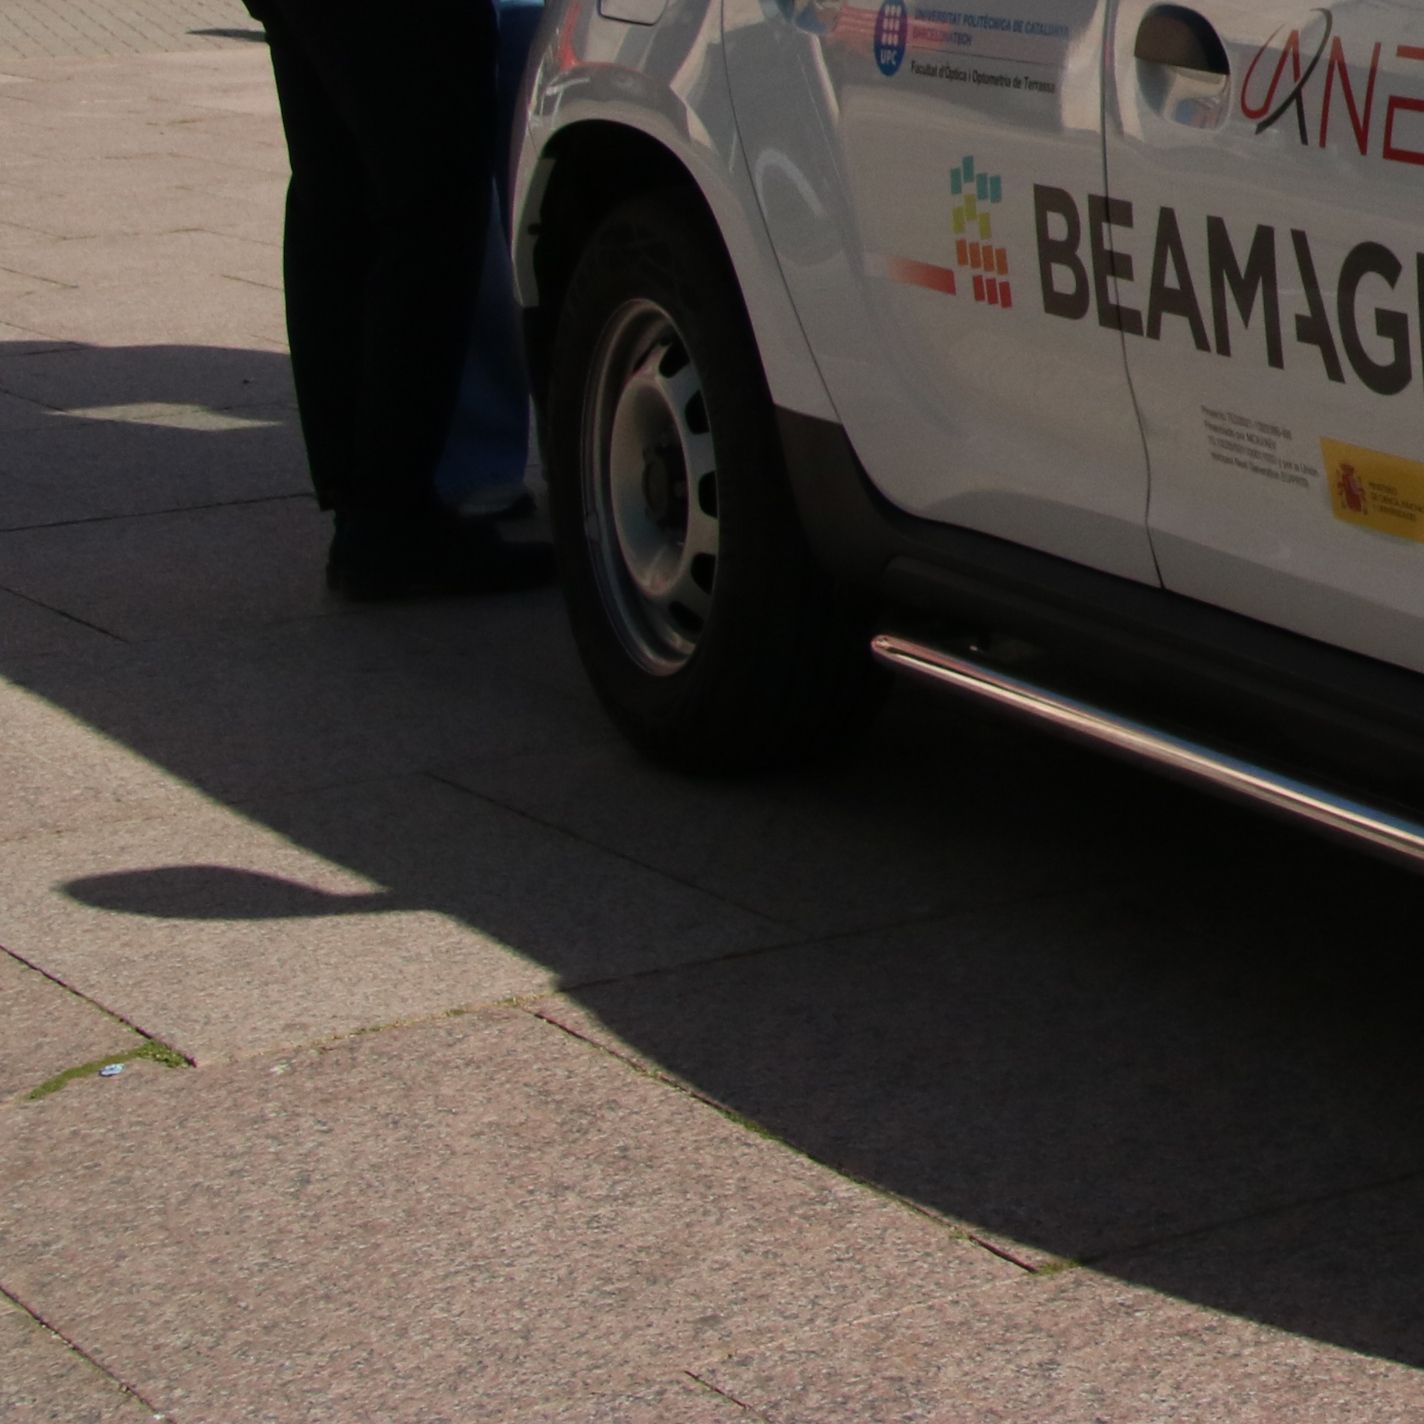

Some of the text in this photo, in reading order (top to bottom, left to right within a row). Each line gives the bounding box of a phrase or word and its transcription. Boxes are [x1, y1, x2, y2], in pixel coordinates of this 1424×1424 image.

[914, 7, 962, 24] UNIVERSITAT
[1013, 20, 1023, 33] DE
[880, 49, 897, 65] UPC
[911, 60, 938, 77] Facultat
[972, 69, 1012, 87] Optometria
[1013, 75, 1022, 88] de
[1024, 76, 1056, 93] Terrassa
